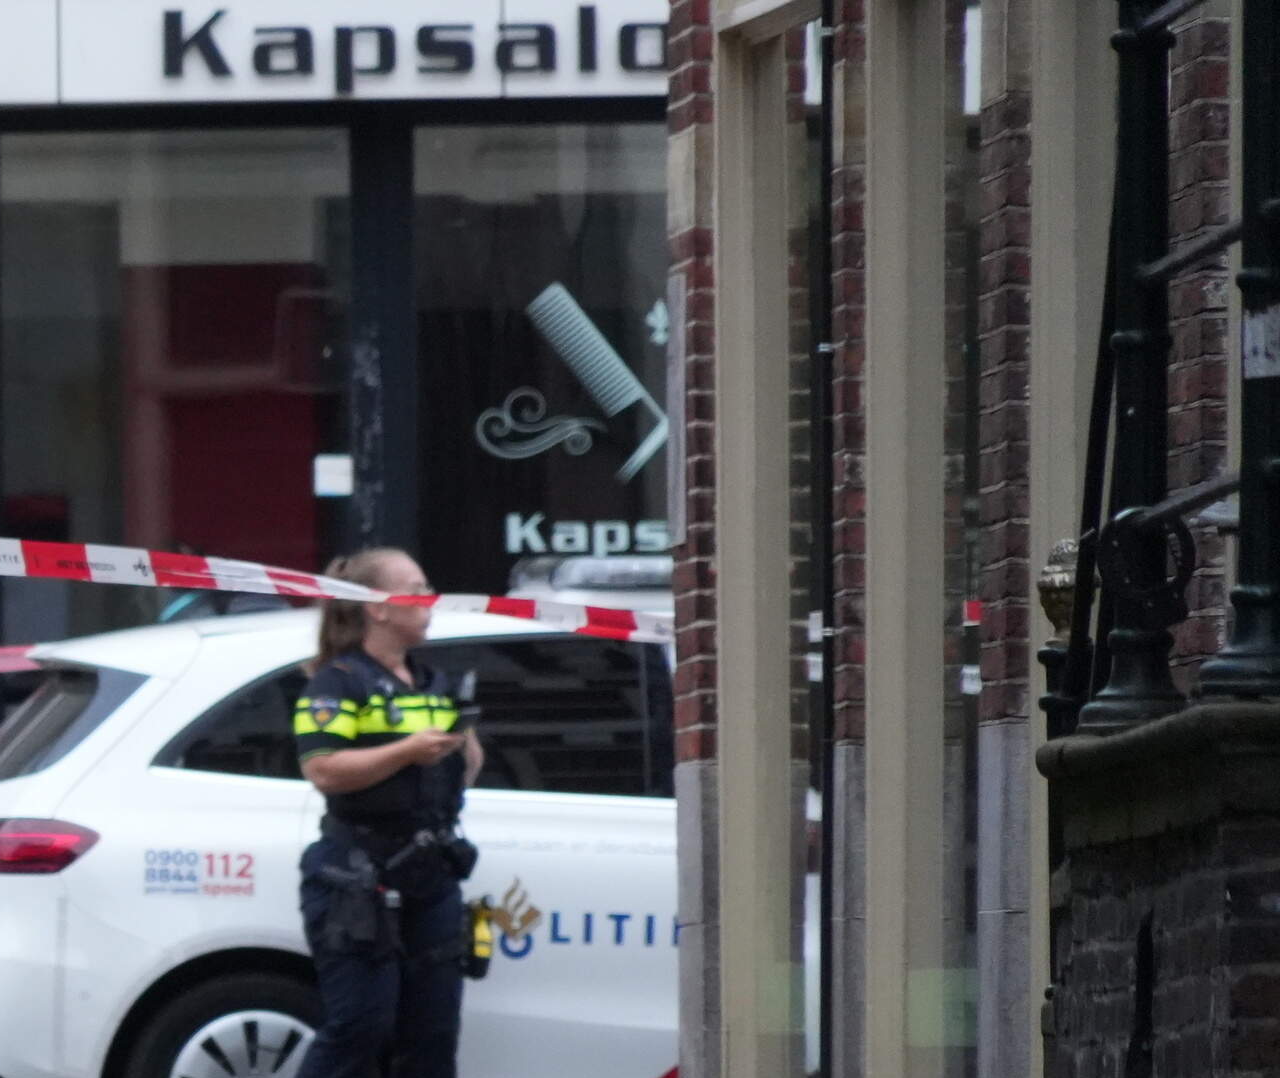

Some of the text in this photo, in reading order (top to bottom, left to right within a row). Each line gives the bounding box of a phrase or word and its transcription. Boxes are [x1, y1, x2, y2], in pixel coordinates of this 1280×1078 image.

[144, 850, 255, 879] 0900 112
[499, 911, 681, 960] OLITI
